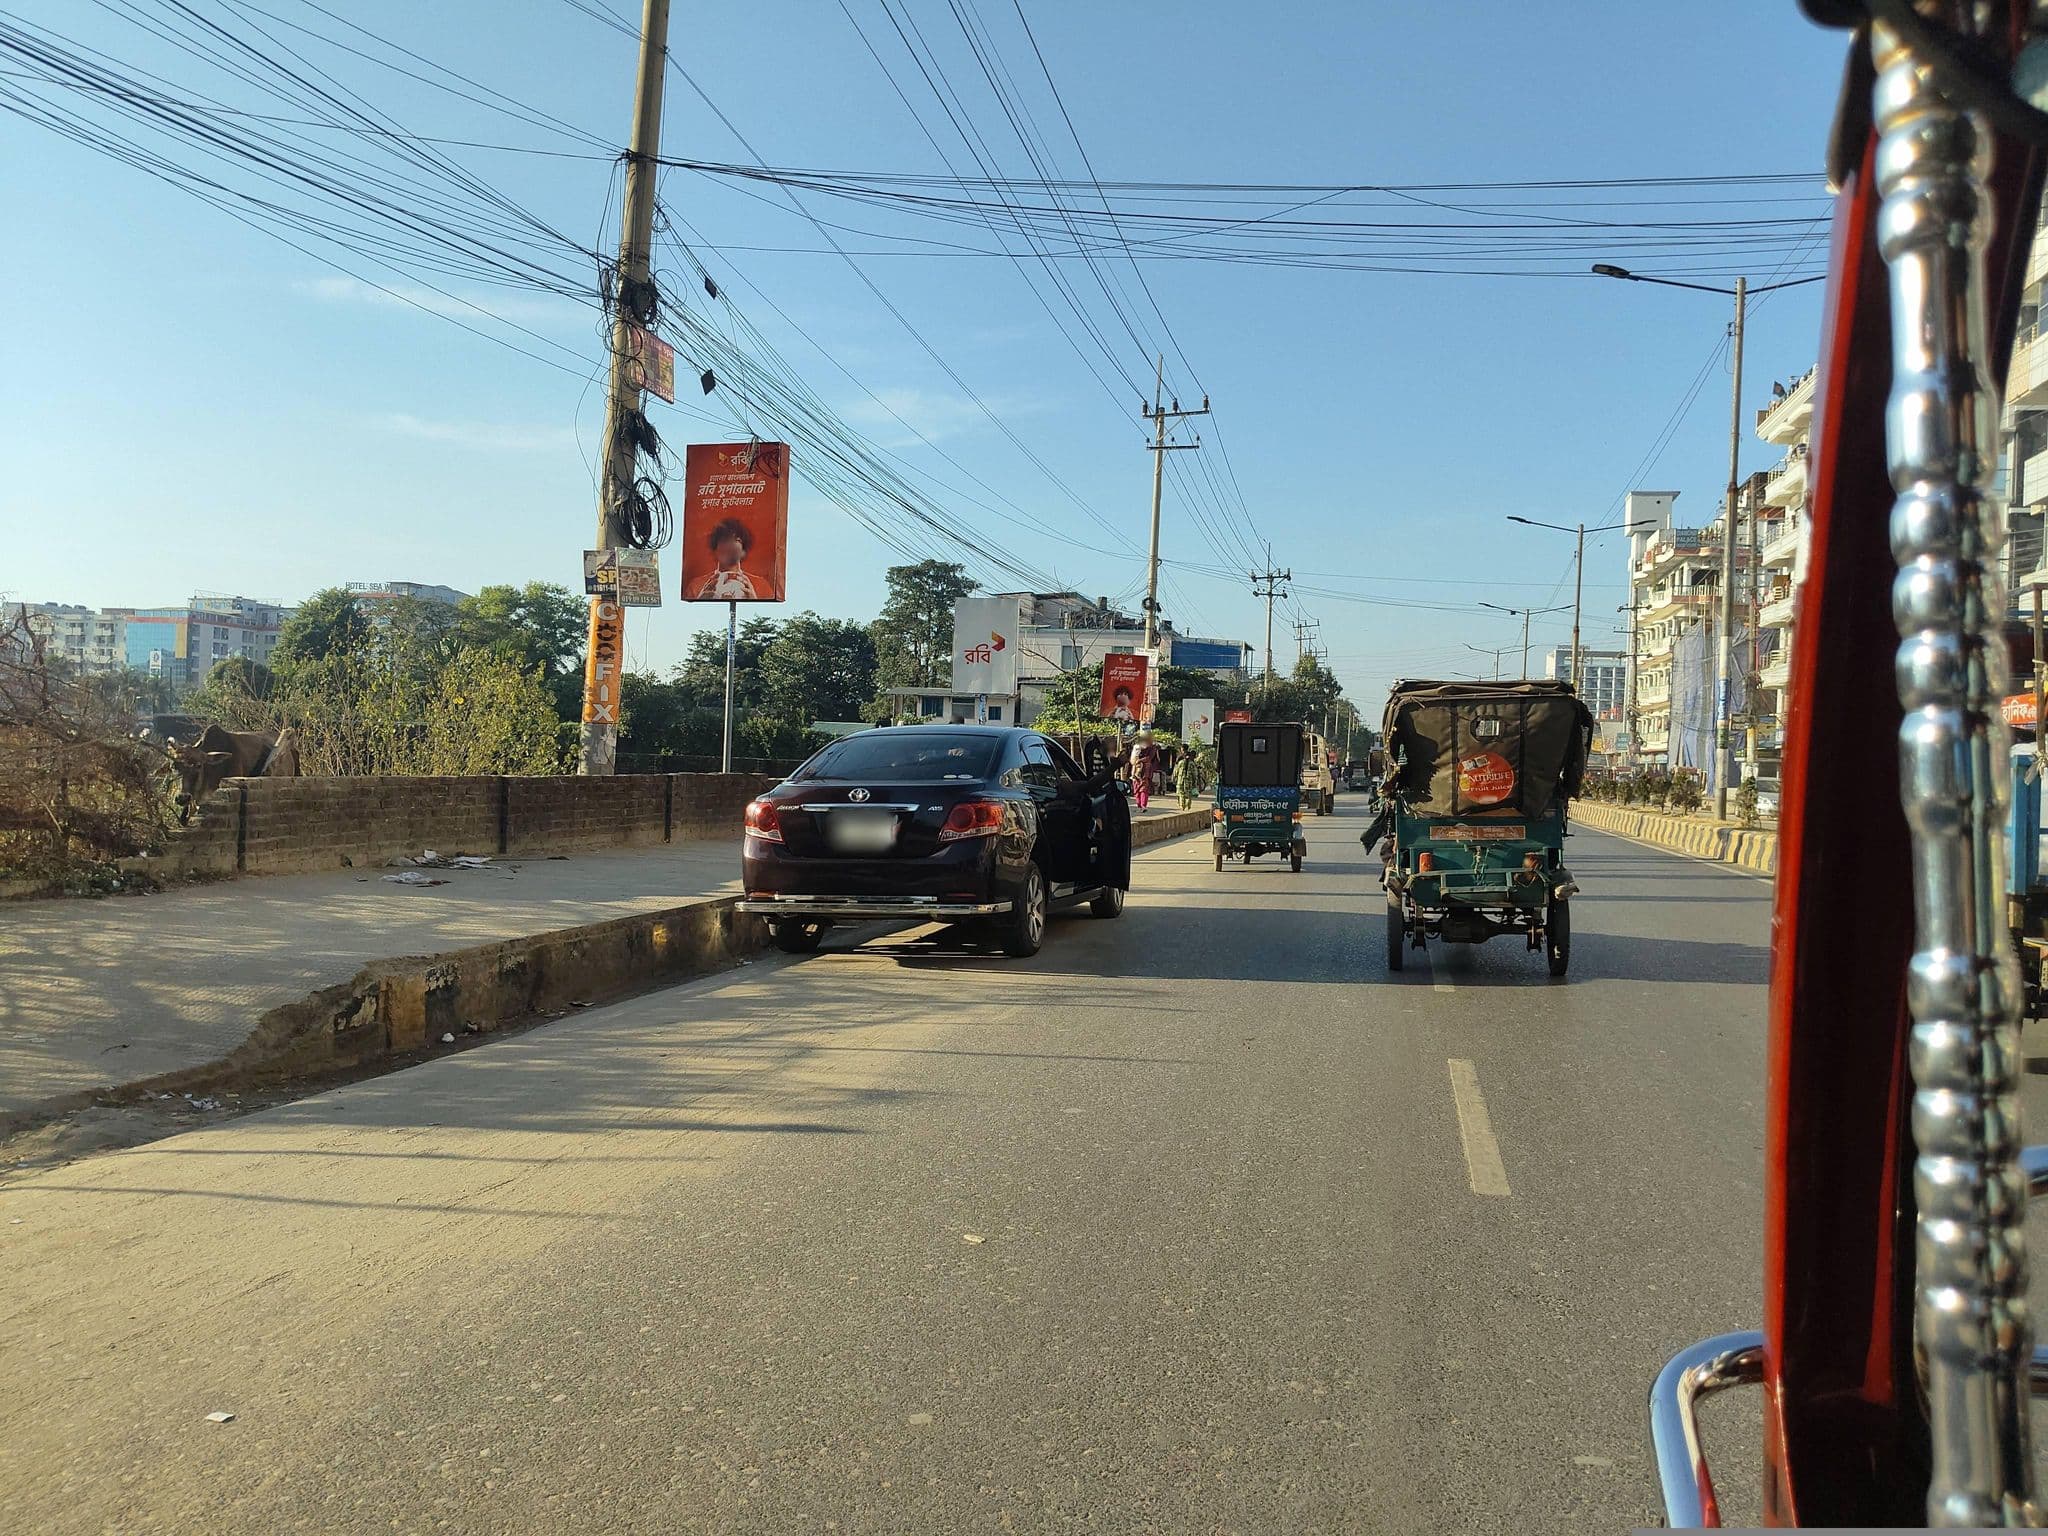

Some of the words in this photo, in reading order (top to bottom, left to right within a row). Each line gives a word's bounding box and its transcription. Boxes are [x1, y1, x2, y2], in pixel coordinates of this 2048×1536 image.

[730, 451, 747, 466] রবি
[697, 482, 718, 496] রবি
[718, 482, 766, 497] সুপারনেটে
[346, 581, 367, 590] HOTEL
[369, 582, 383, 591] SEA
[964, 643, 991, 665] রবি
[2001, 699, 2029, 723] হানিফ
[1468, 771, 1511, 782] NUTRILIFE
